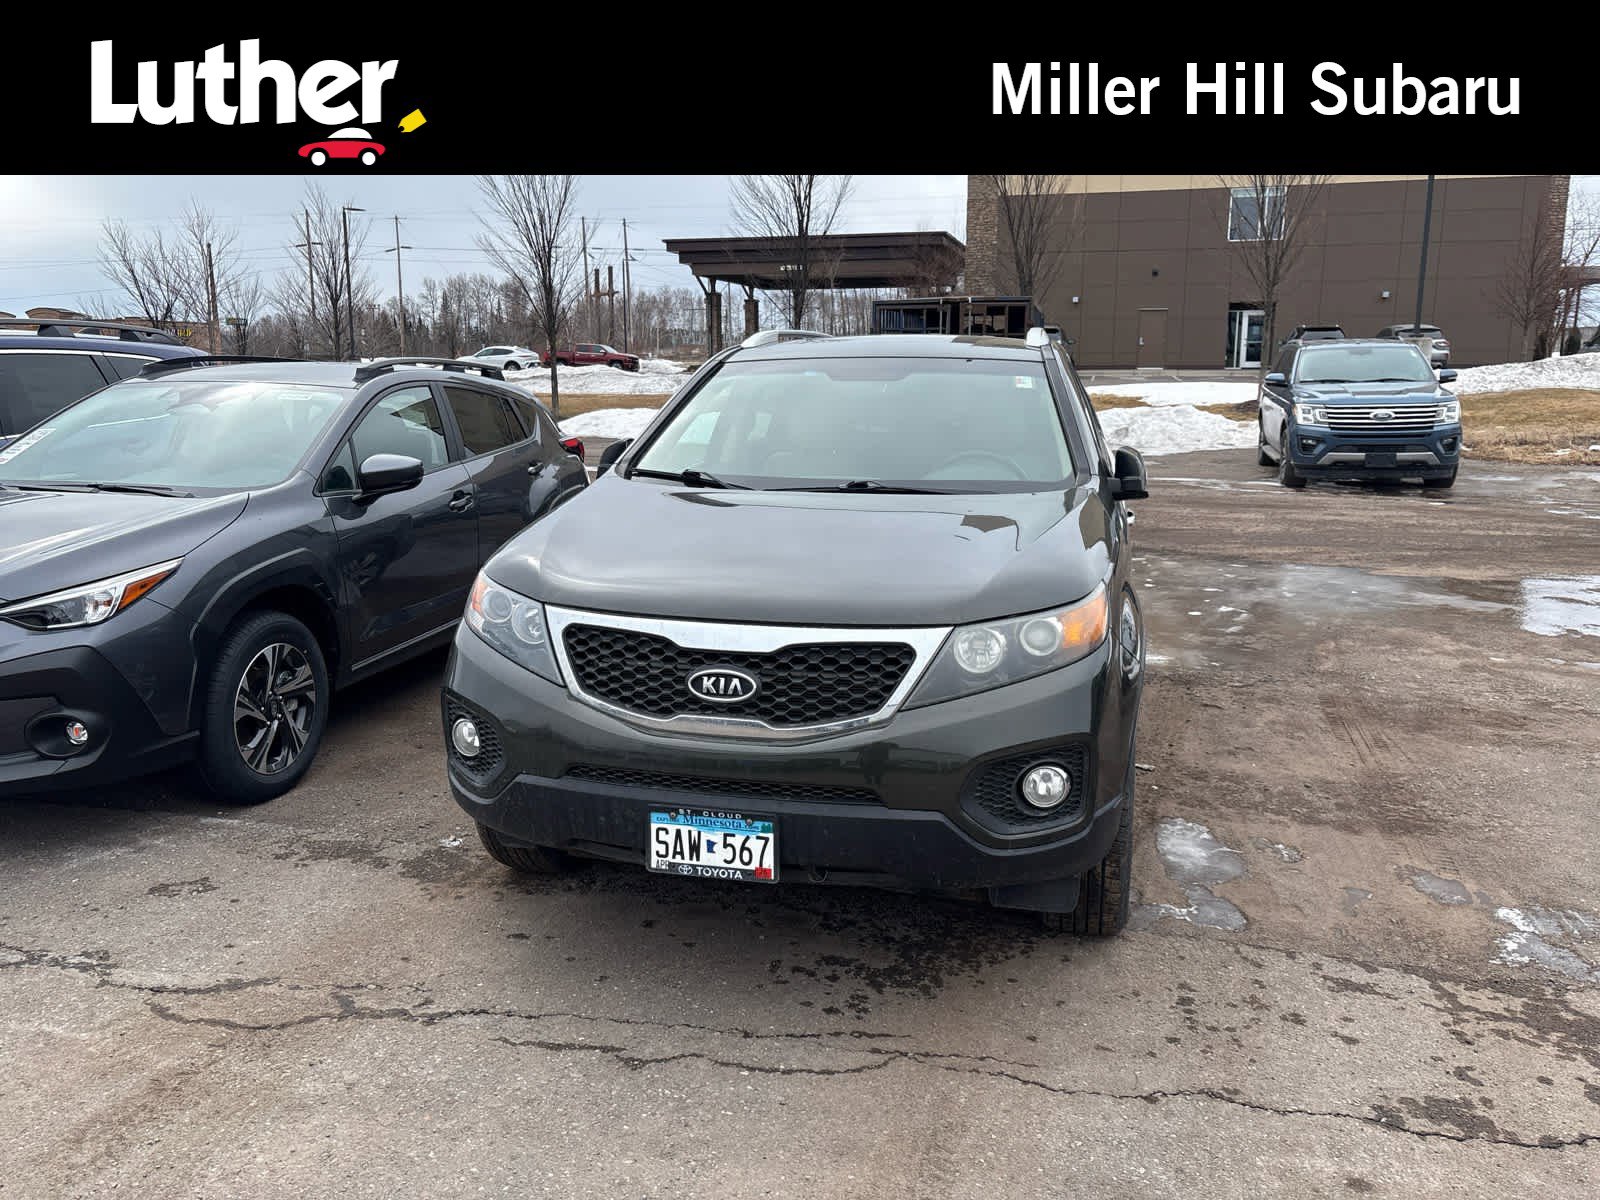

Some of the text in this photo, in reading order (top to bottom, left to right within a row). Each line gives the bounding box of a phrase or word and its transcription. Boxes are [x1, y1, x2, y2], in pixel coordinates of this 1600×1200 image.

[701, 676, 743, 696] KIA
[683, 815, 742, 829] Minnesota
[702, 811, 742, 819] CLOUD
[656, 827, 770, 868] SAW 567
[695, 866, 743, 880] TOYOTA
